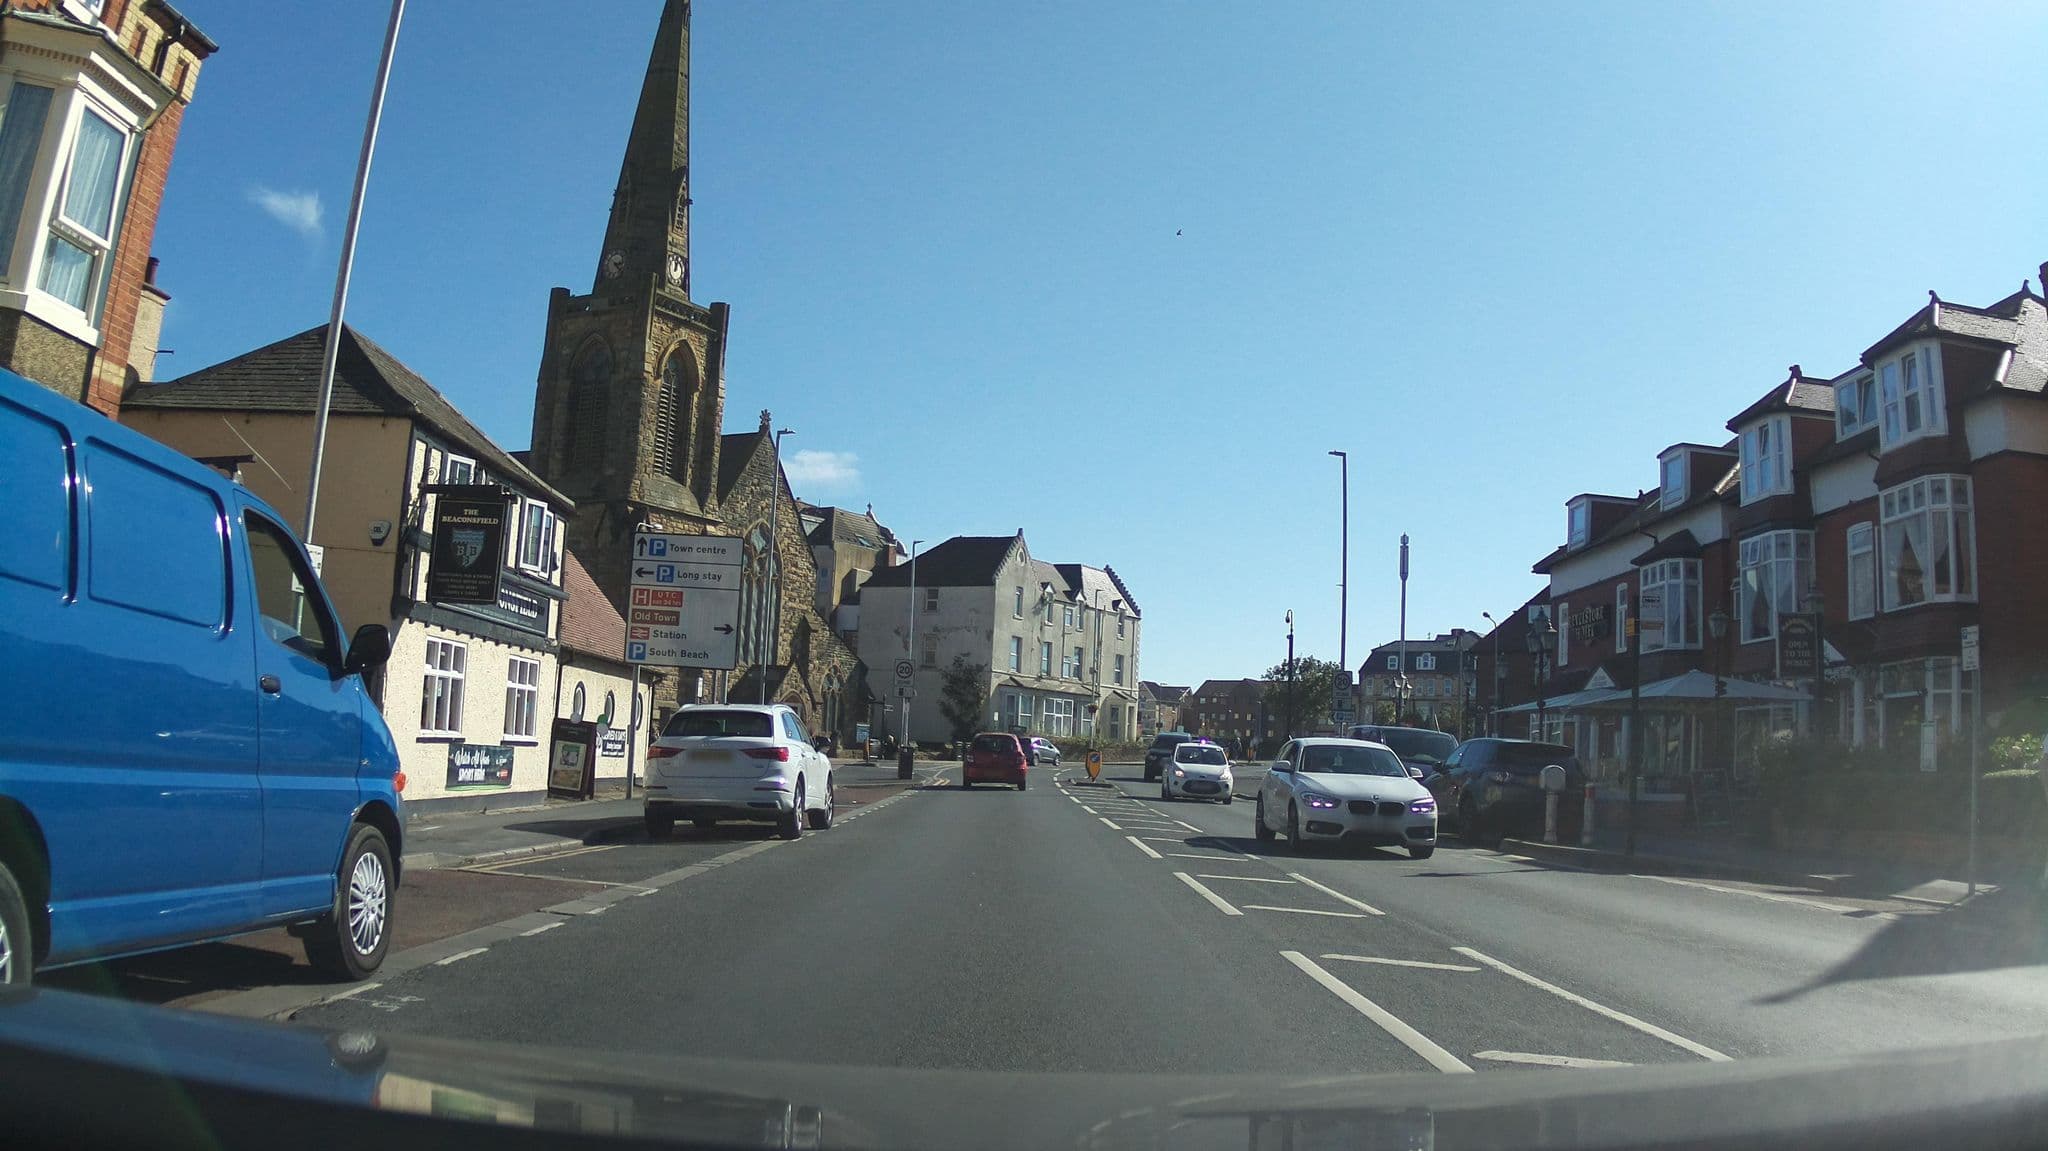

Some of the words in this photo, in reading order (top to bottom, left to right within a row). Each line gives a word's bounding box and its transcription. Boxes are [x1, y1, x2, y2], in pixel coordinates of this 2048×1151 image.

[464, 508, 479, 516] THE
[441, 516, 499, 525] BEACONSFIELD
[669, 543, 693, 553] Town
[696, 544, 727, 555] centre
[677, 569, 700, 580] Long
[702, 570, 722, 582] stay
[635, 589, 648, 605] H
[634, 611, 651, 620] Old
[654, 612, 677, 621] Town
[653, 629, 687, 639] Station
[649, 647, 677, 657] South
[680, 649, 709, 660] Beach
[899, 665, 910, 675] 20
